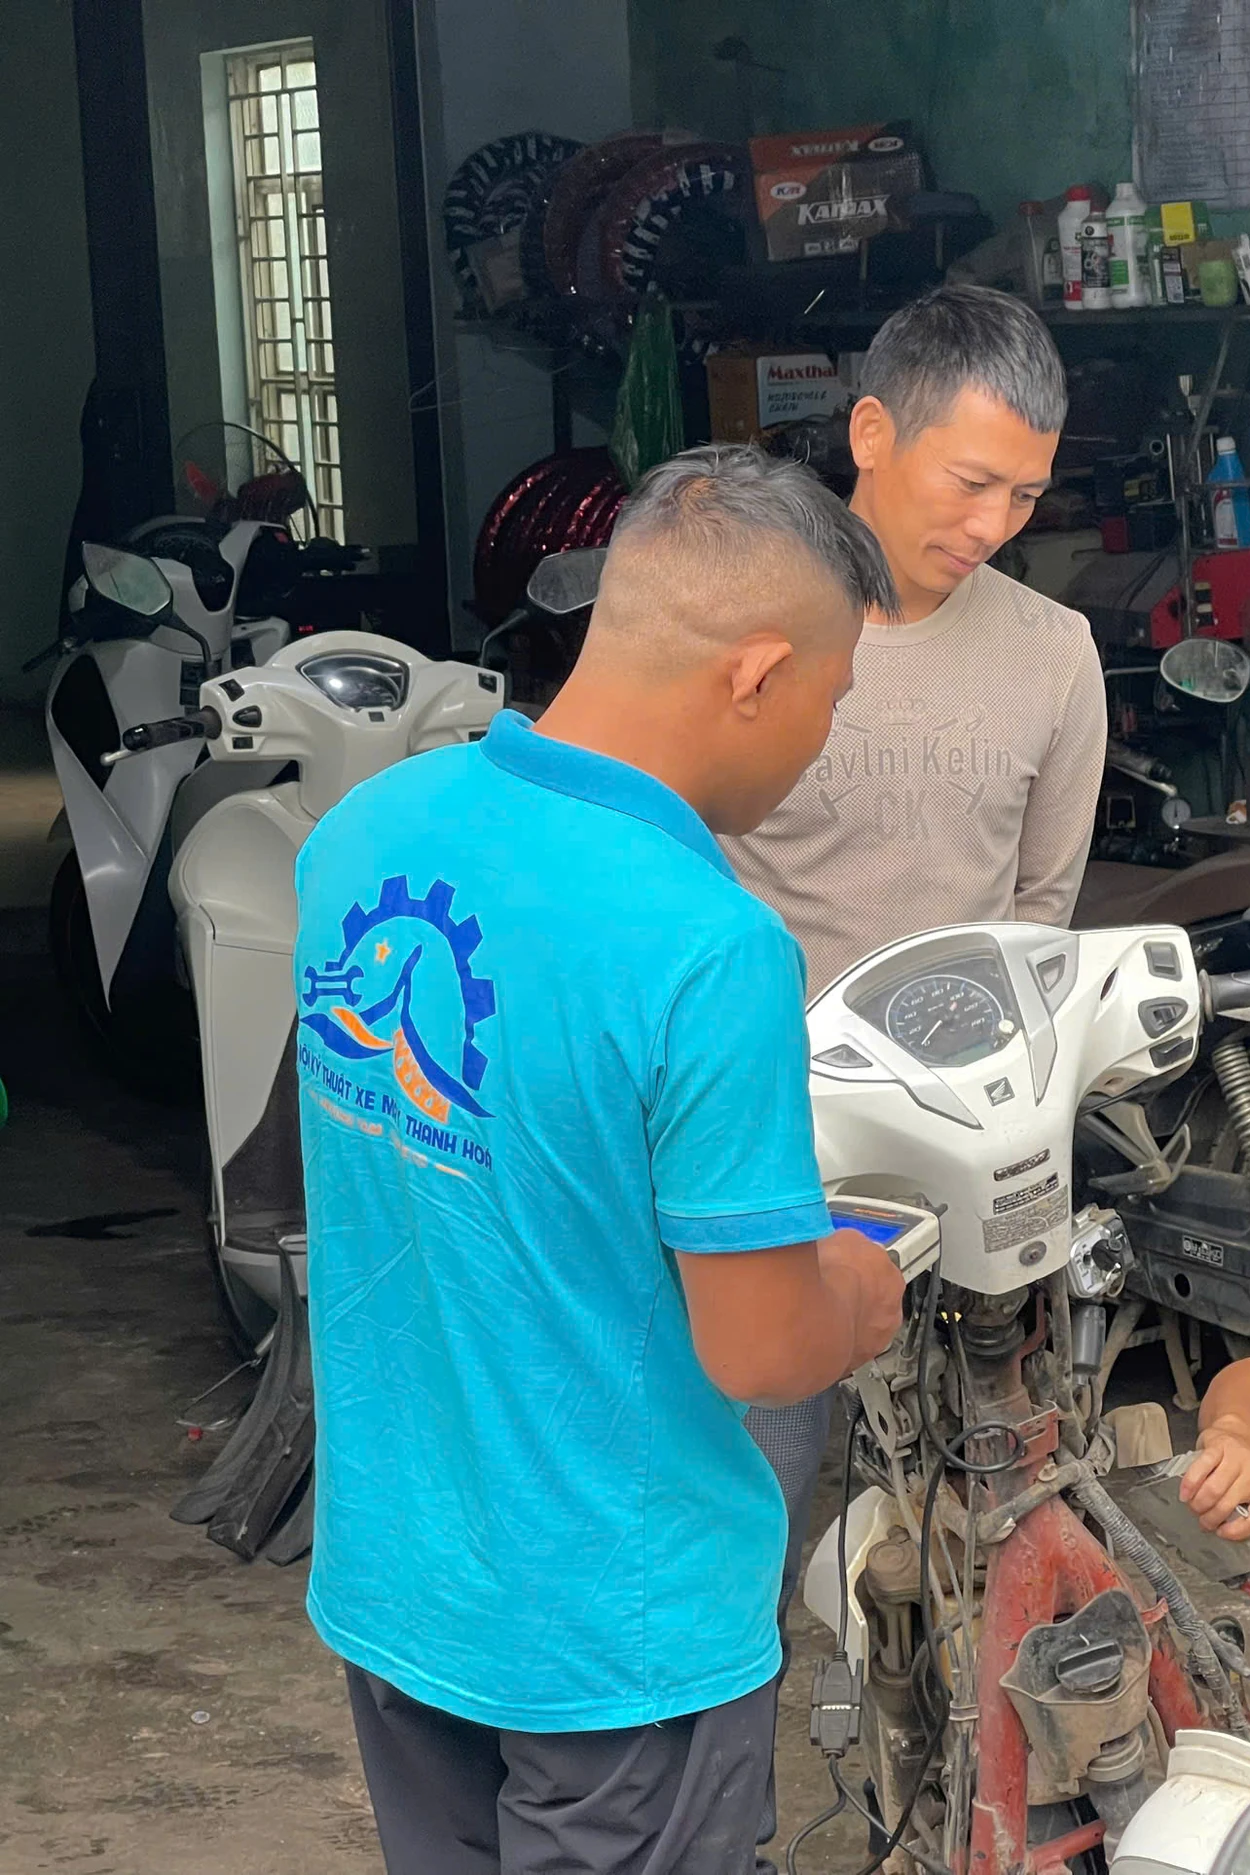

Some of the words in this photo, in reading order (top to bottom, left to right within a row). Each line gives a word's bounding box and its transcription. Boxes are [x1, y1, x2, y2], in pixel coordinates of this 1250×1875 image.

[799, 737, 910, 784] avlni
[922, 736, 1012, 777] Kelin
[323, 1064, 352, 1101] THUẬT
[355, 1085, 376, 1111] XE
[406, 1114, 458, 1154] THANH
